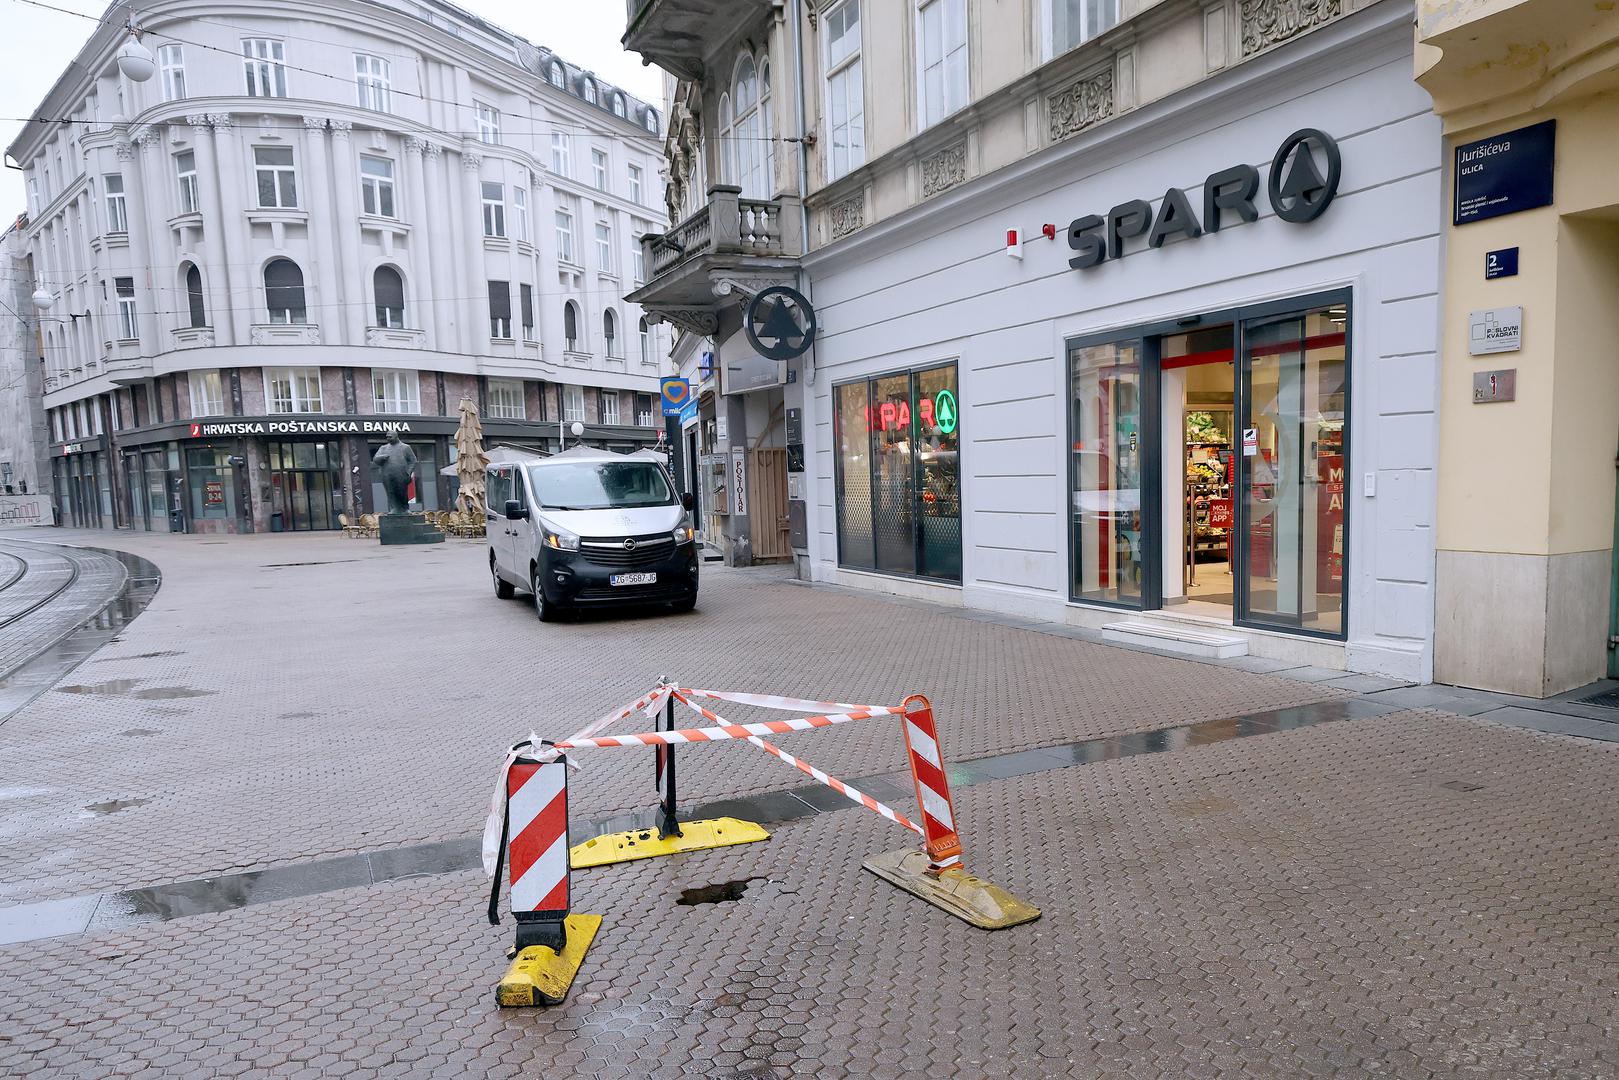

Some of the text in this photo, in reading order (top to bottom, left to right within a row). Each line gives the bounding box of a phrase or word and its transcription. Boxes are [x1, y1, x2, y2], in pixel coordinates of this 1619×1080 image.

[1461, 141, 1511, 163] Jurišićeva
[1461, 163, 1484, 175] ULICA
[1068, 164, 1259, 269] SPAR
[1489, 254, 1497, 267] 2
[1486, 330, 1519, 339] KVADRATI
[203, 420, 411, 435] HRVATSKA POŠTANSKA BANKA
[736, 461, 744, 512] POSTOLAR
[1211, 514, 1227, 522] APP
[616, 575, 625, 584] ZG
